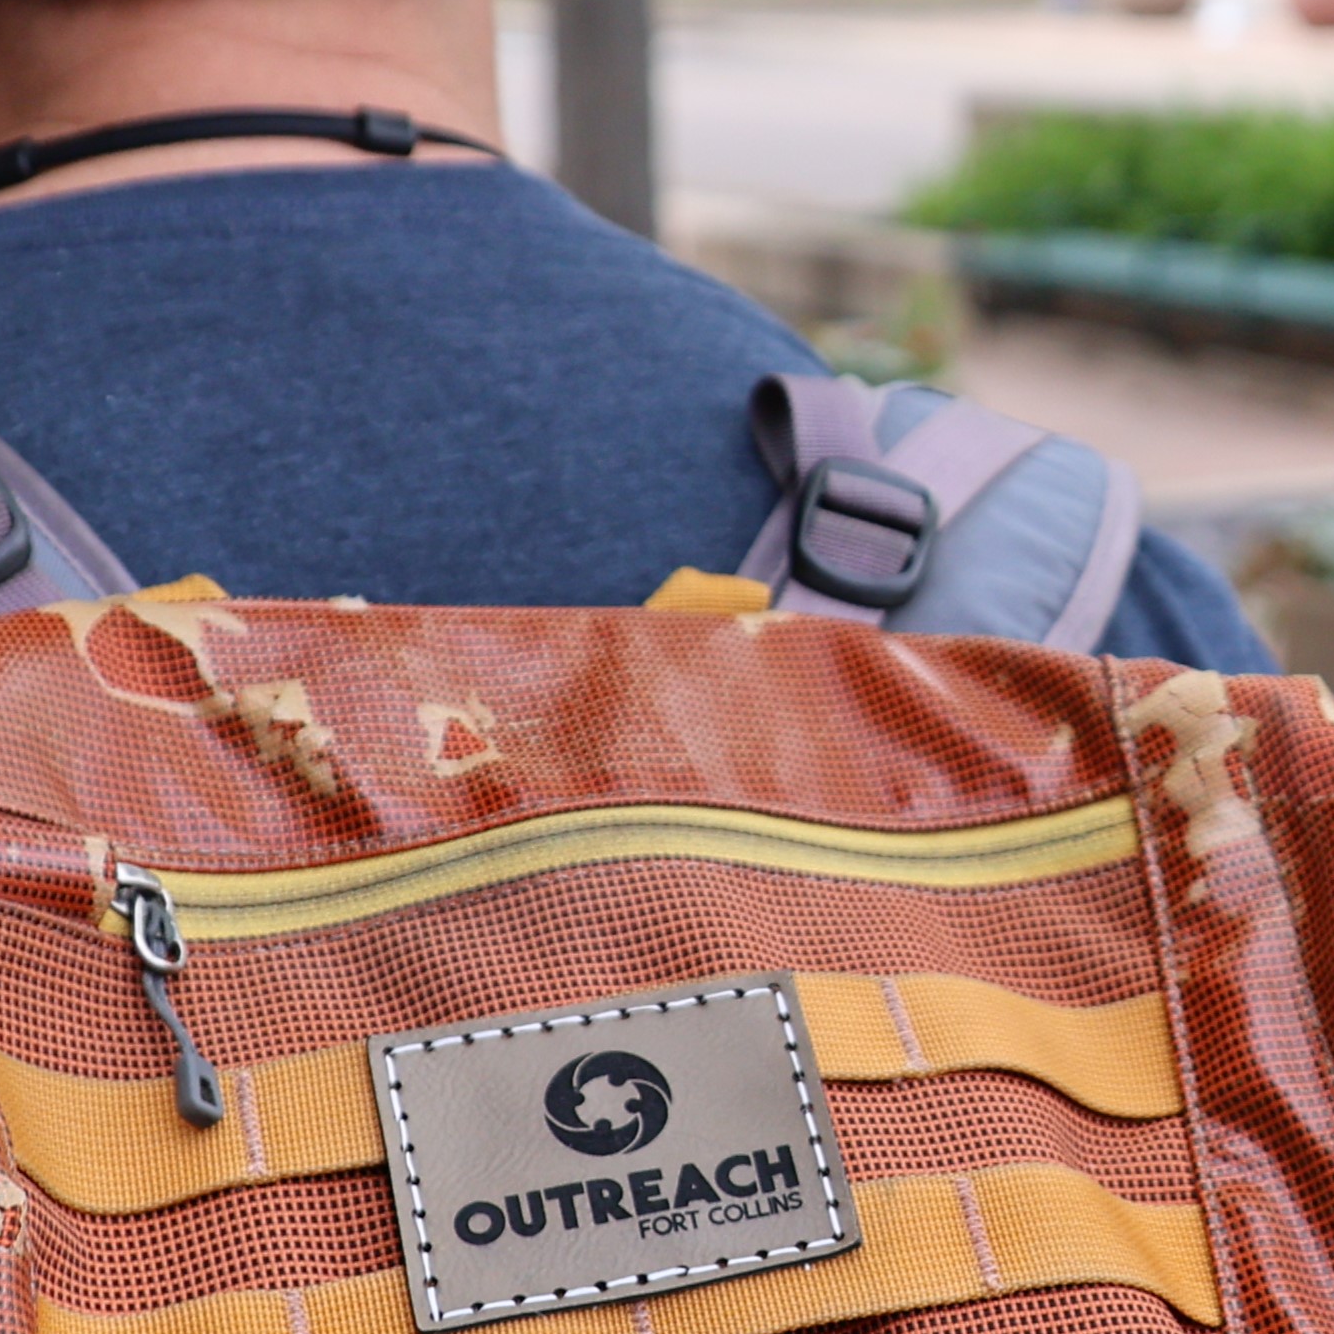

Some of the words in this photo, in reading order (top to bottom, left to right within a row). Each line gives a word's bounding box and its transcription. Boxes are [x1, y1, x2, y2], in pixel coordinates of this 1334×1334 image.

[454, 1145, 800, 1246] OUTREACH
[638, 1209, 703, 1239] FORT
[708, 1191, 803, 1226] COLLINS
